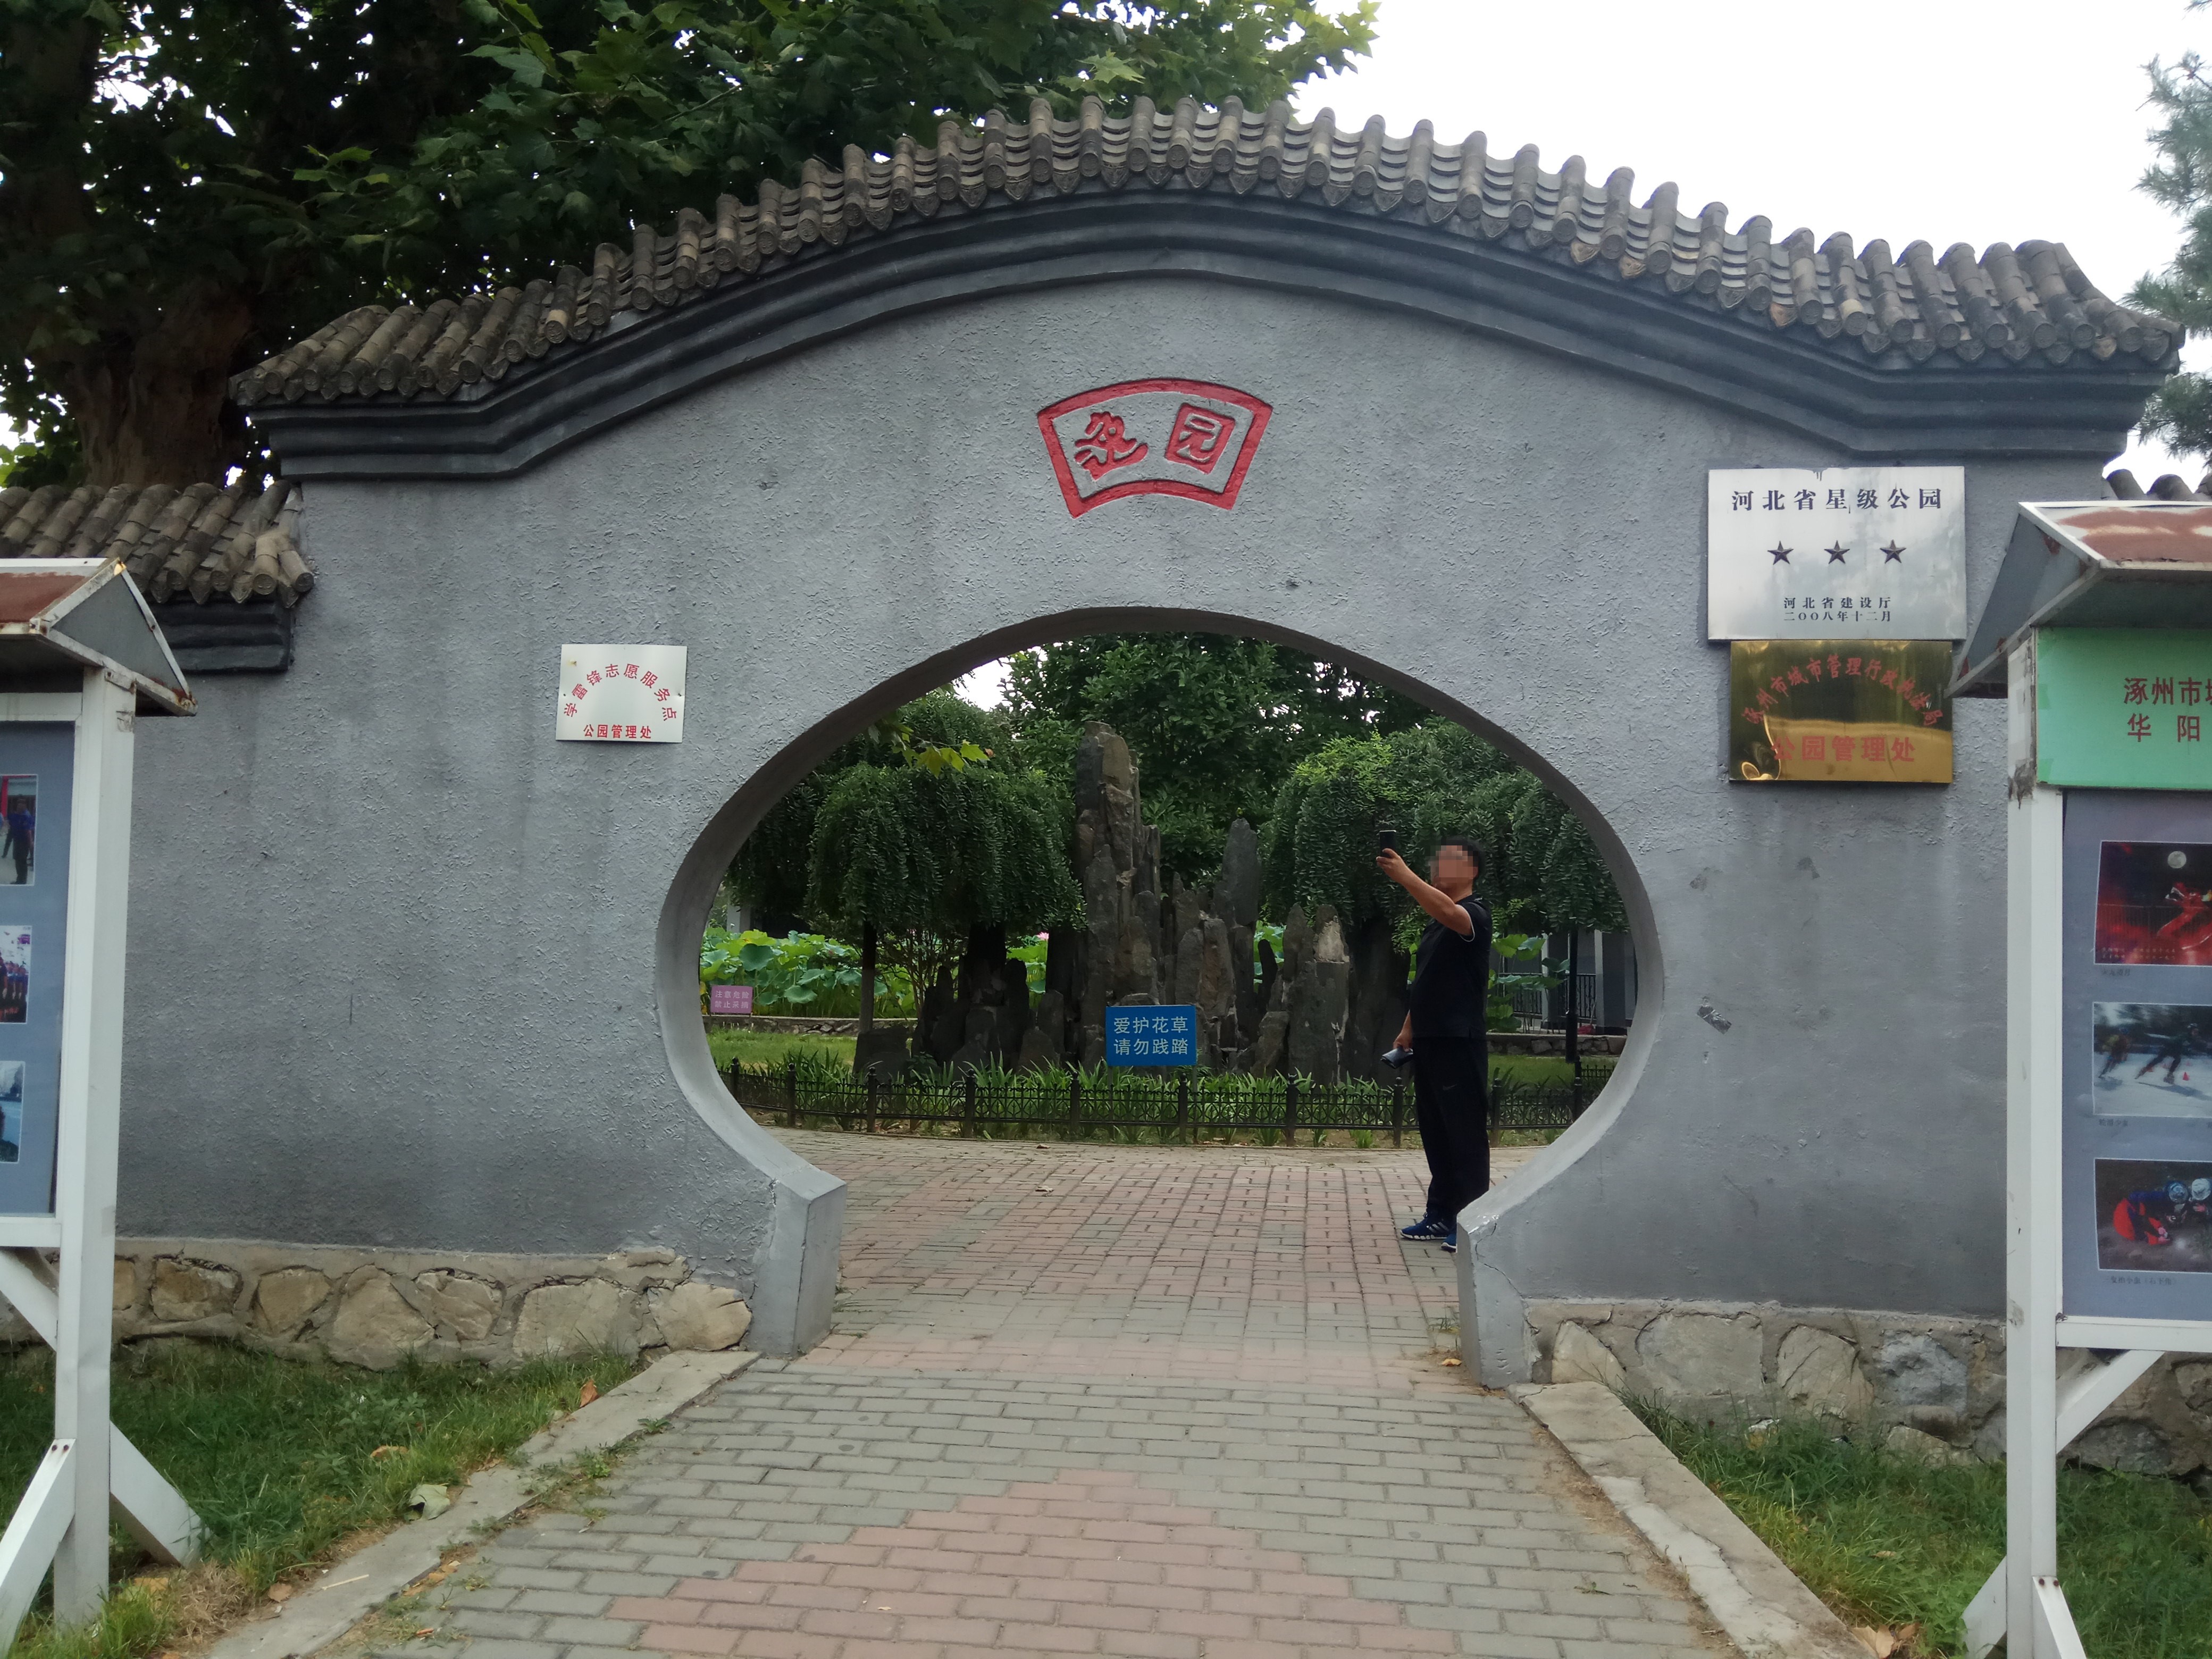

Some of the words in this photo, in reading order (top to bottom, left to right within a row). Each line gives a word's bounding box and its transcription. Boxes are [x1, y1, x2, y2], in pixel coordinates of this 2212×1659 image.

[1732, 488, 1941, 510] 河北省星级公园
[1784, 597, 1891, 608] 河北省建设厅
[564, 664, 677, 721] 学雷锋志愿服务点
[2124, 677, 2212, 706] 涿州市
[583, 724, 651, 739] 公园管理处
[1771, 736, 1915, 761] 公园管理处
[1114, 1017, 1188, 1034] 爱护花草
[1113, 1038, 1188, 1055] 请勿践踏
